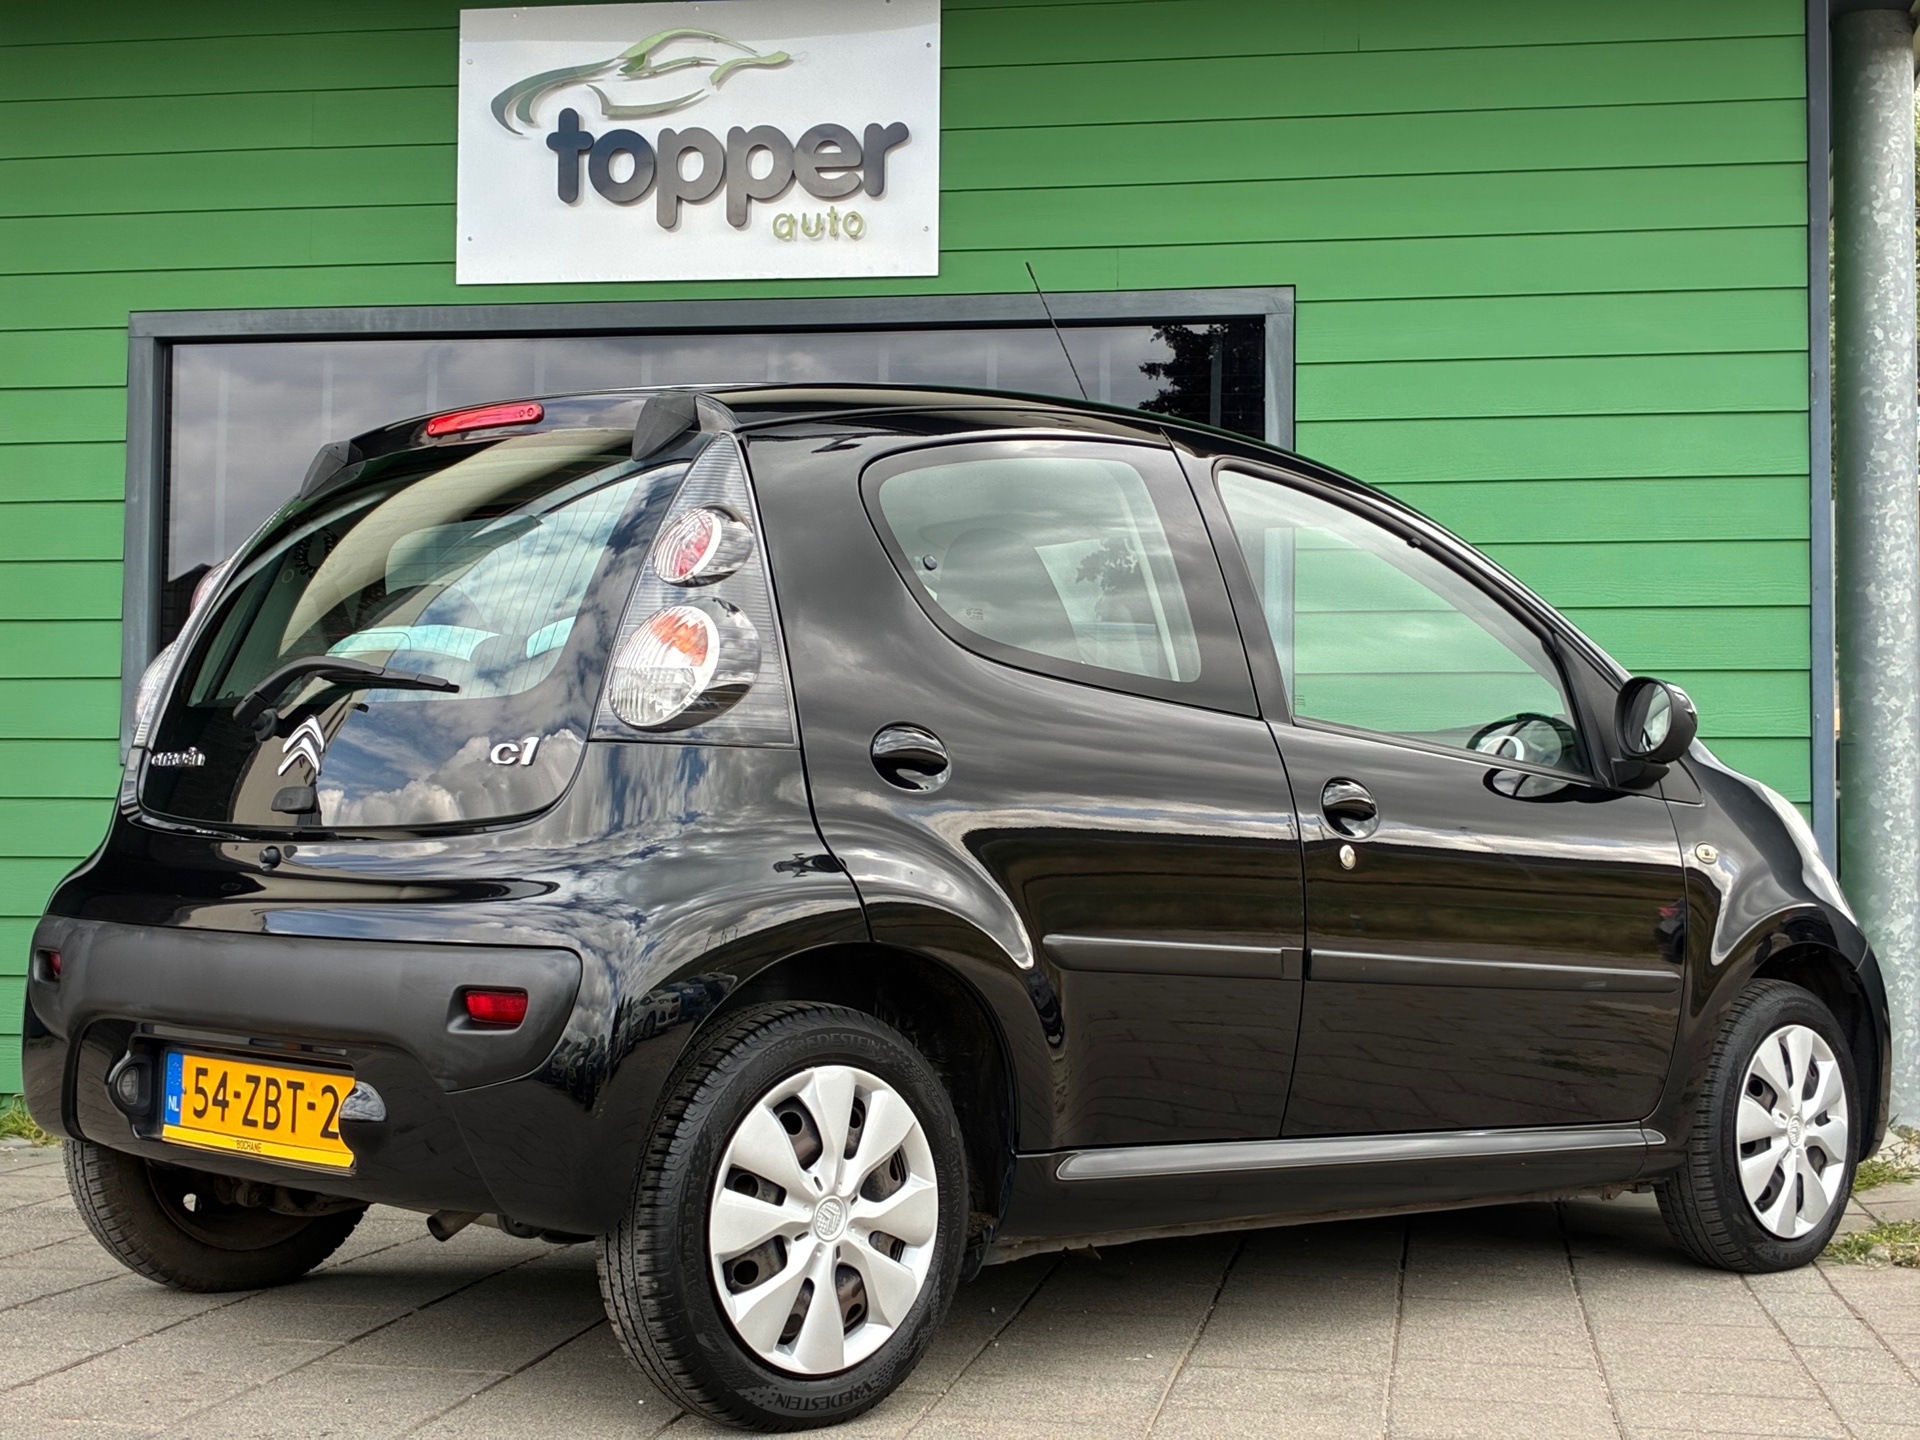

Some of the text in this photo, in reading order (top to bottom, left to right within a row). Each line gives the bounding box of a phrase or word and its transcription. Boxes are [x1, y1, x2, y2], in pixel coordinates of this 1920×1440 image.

[546, 107, 910, 229] topper
[772, 205, 864, 240] auto
[168, 1094, 180, 1112] NL
[192, 1066, 340, 1140] 54-ZBT-2
[774, 1380, 876, 1411] VREDESTEIN
